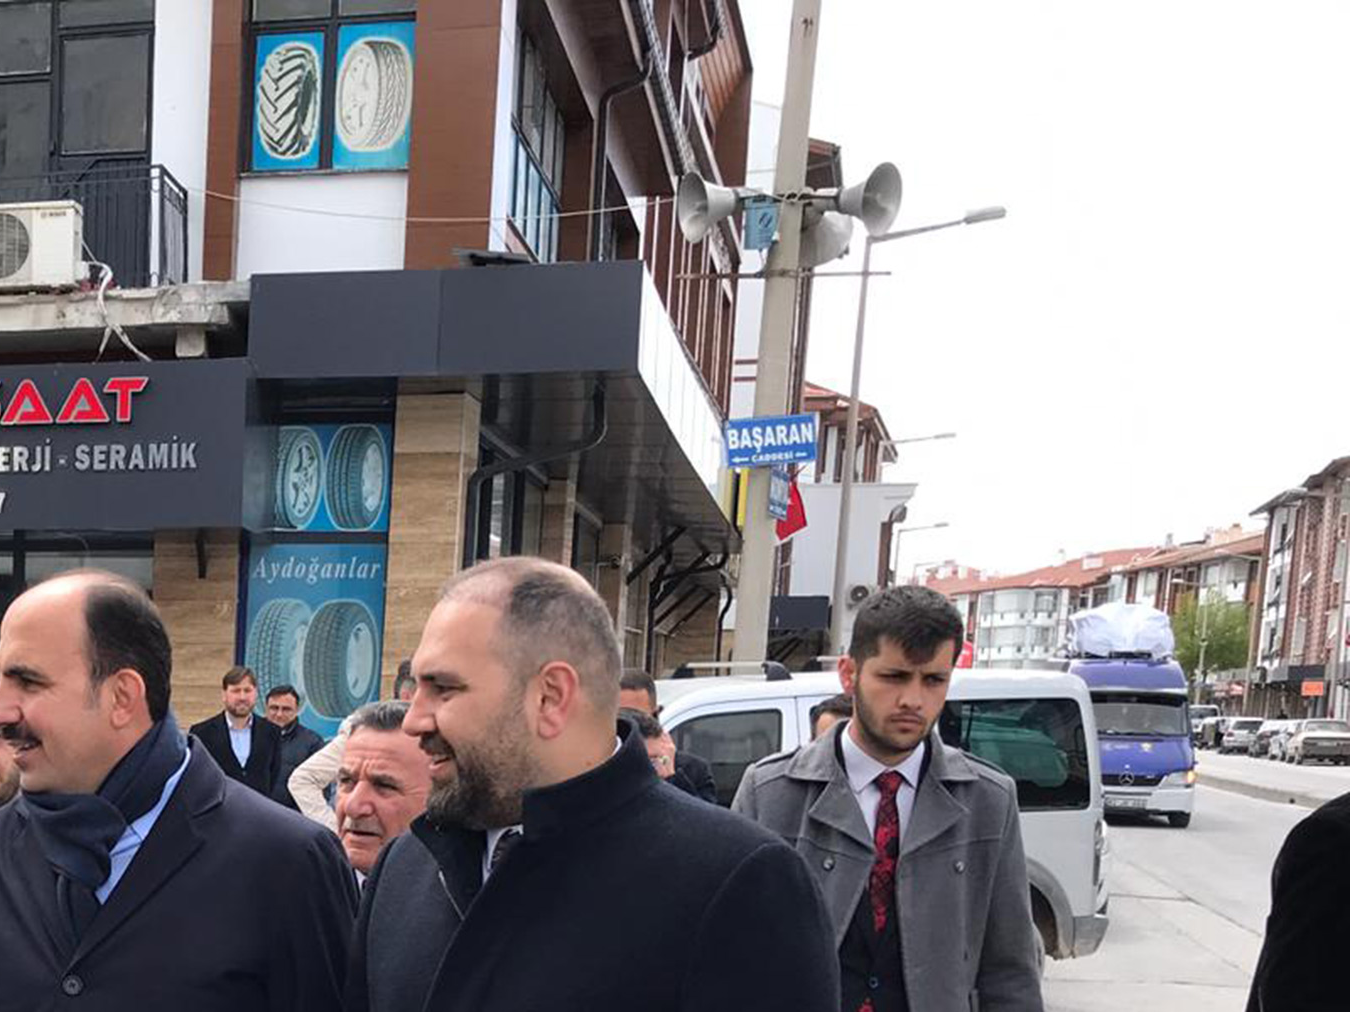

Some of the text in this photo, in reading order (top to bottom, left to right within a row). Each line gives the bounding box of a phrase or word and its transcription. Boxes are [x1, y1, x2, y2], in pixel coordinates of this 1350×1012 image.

[727, 422, 814, 453] BAŞARAN
[74, 436, 198, 472] SERAMİK
[252, 556, 381, 585] Aydoğanlar
